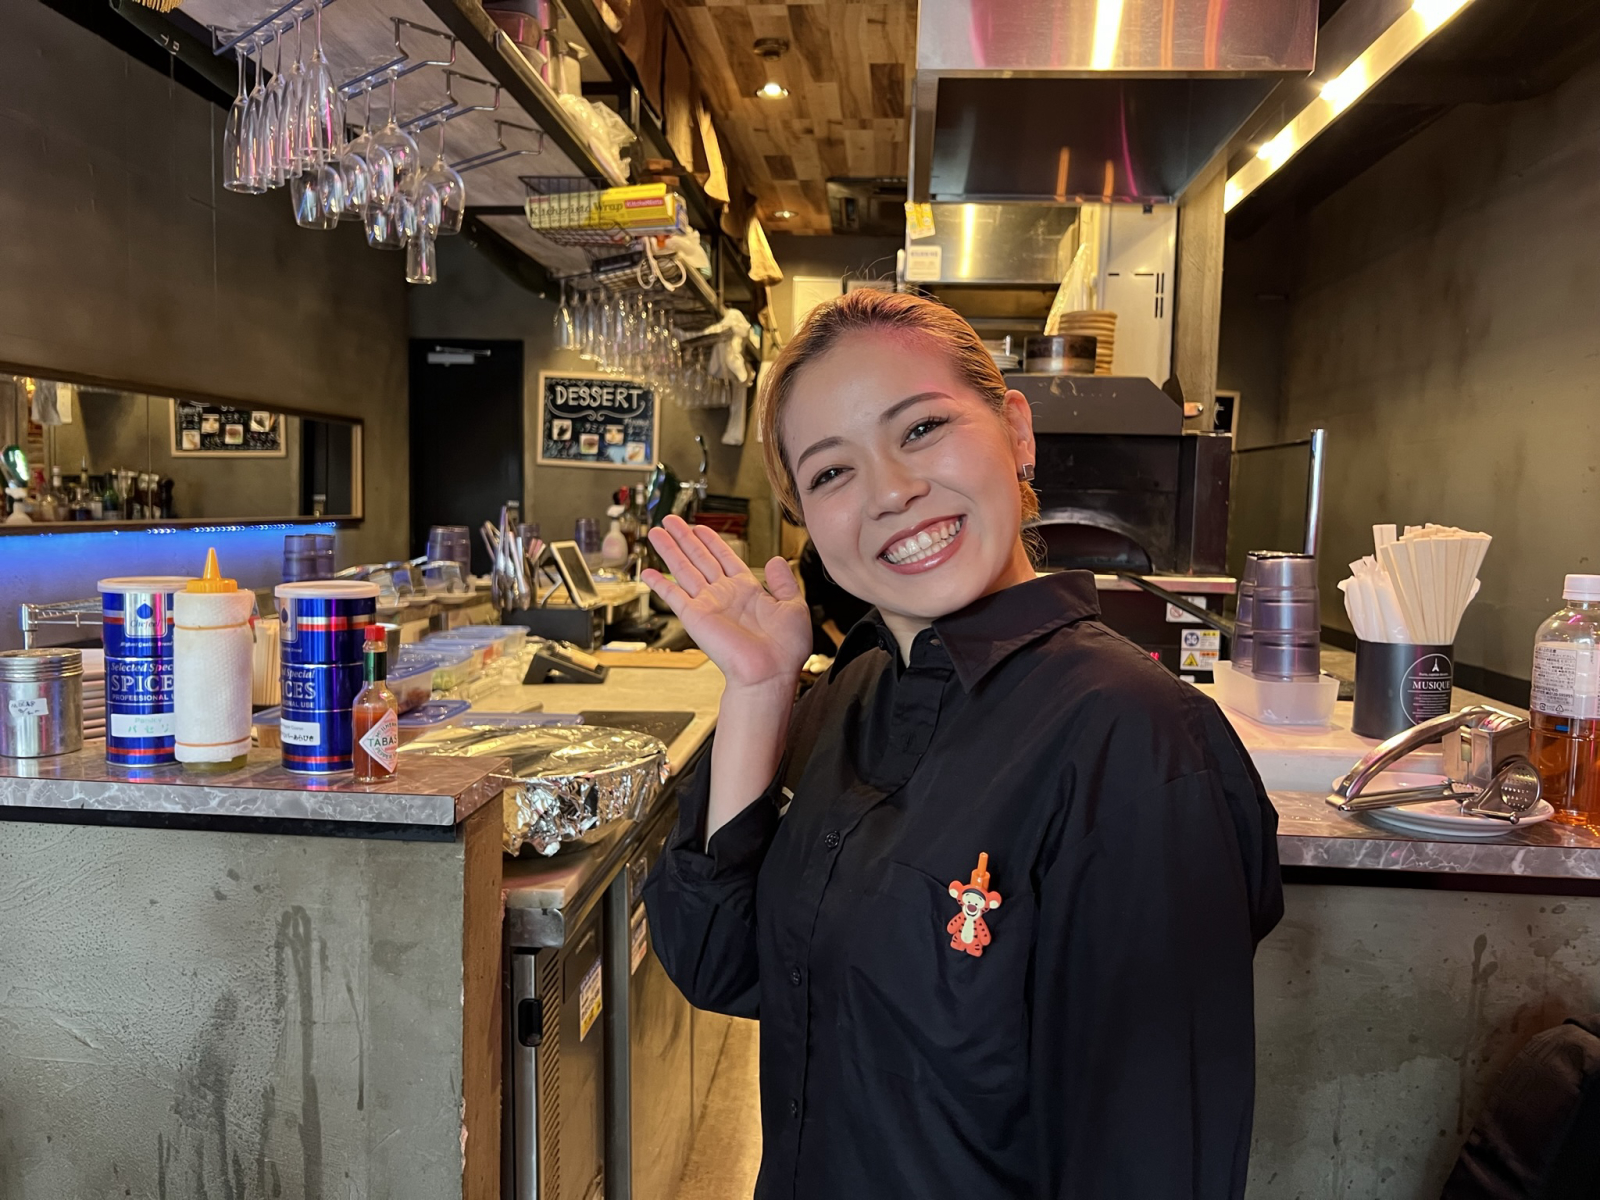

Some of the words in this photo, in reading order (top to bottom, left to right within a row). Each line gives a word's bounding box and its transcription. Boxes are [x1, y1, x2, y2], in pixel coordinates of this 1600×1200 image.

[593, 201, 624, 212] Wrap
[555, 385, 643, 409] DESSERT
[111, 663, 147, 672] Selected
[148, 663, 174, 674] Spec
[286, 667, 316, 679] Special
[111, 674, 174, 692] SPICE
[1412, 680, 1450, 691] MUSIQUE
[282, 680, 317, 699] ICES
[112, 693, 169, 701] PROFESSIONAL
[367, 734, 398, 748] TABAS
